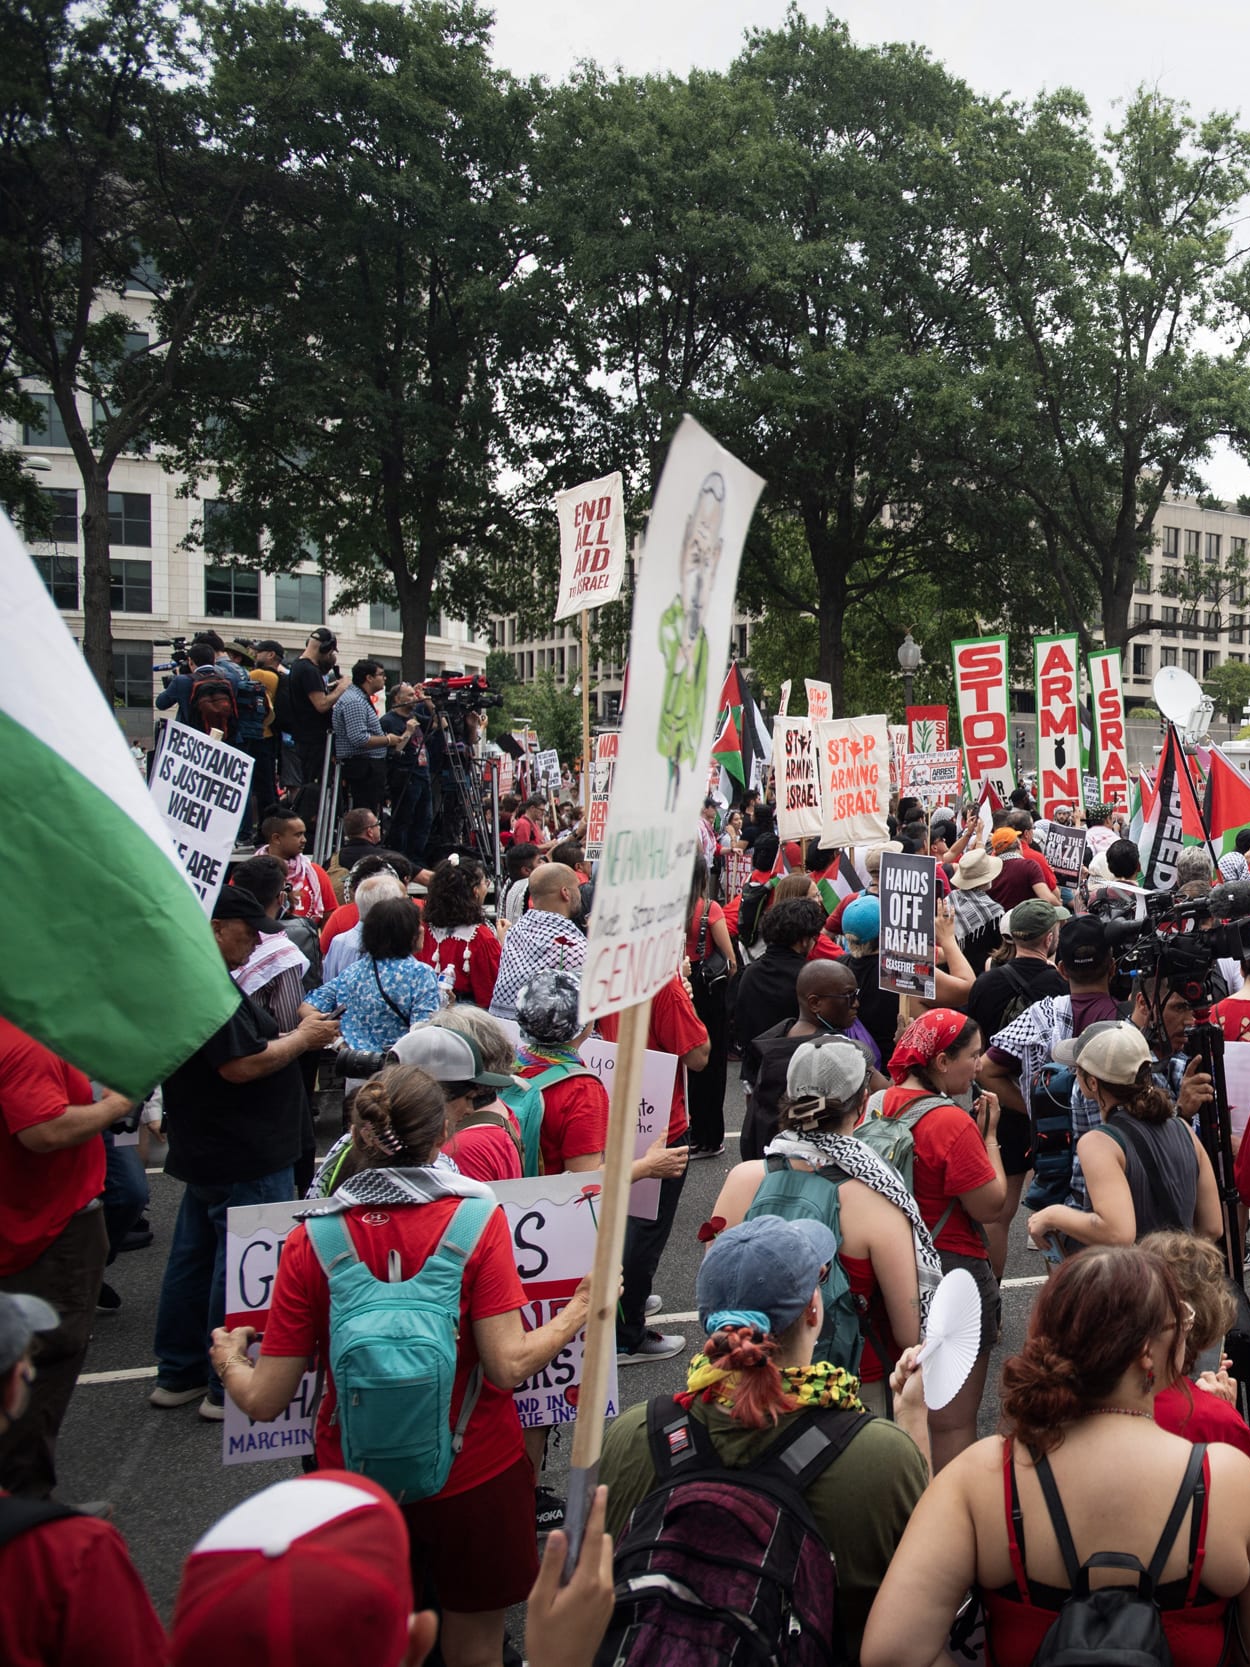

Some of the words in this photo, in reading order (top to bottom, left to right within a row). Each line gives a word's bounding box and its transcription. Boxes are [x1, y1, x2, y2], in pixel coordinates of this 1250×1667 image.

[574, 496, 611, 528] END
[574, 522, 609, 552] ALL
[573, 547, 610, 579] AID
[576, 574, 610, 595] ISRAEL
[958, 644, 1008, 780] STOP
[167, 727, 249, 787] RESISTANCE
[932, 766, 956, 777] ARREST
[159, 754, 175, 782] IS
[172, 764, 242, 814] JUSTIFIED
[830, 763, 879, 793] ARMING
[167, 790, 213, 833] WHEN
[785, 783, 818, 812] ISRAEL
[833, 789, 880, 821] ISRAEL
[1046, 841, 1080, 863] GAZA
[1048, 831, 1066, 844] STOP
[1068, 836, 1084, 848] THE
[186, 850, 222, 886] ARE
[885, 867, 929, 896] HANDS
[889, 892, 924, 930] OFF
[884, 927, 928, 957] RAFAH
